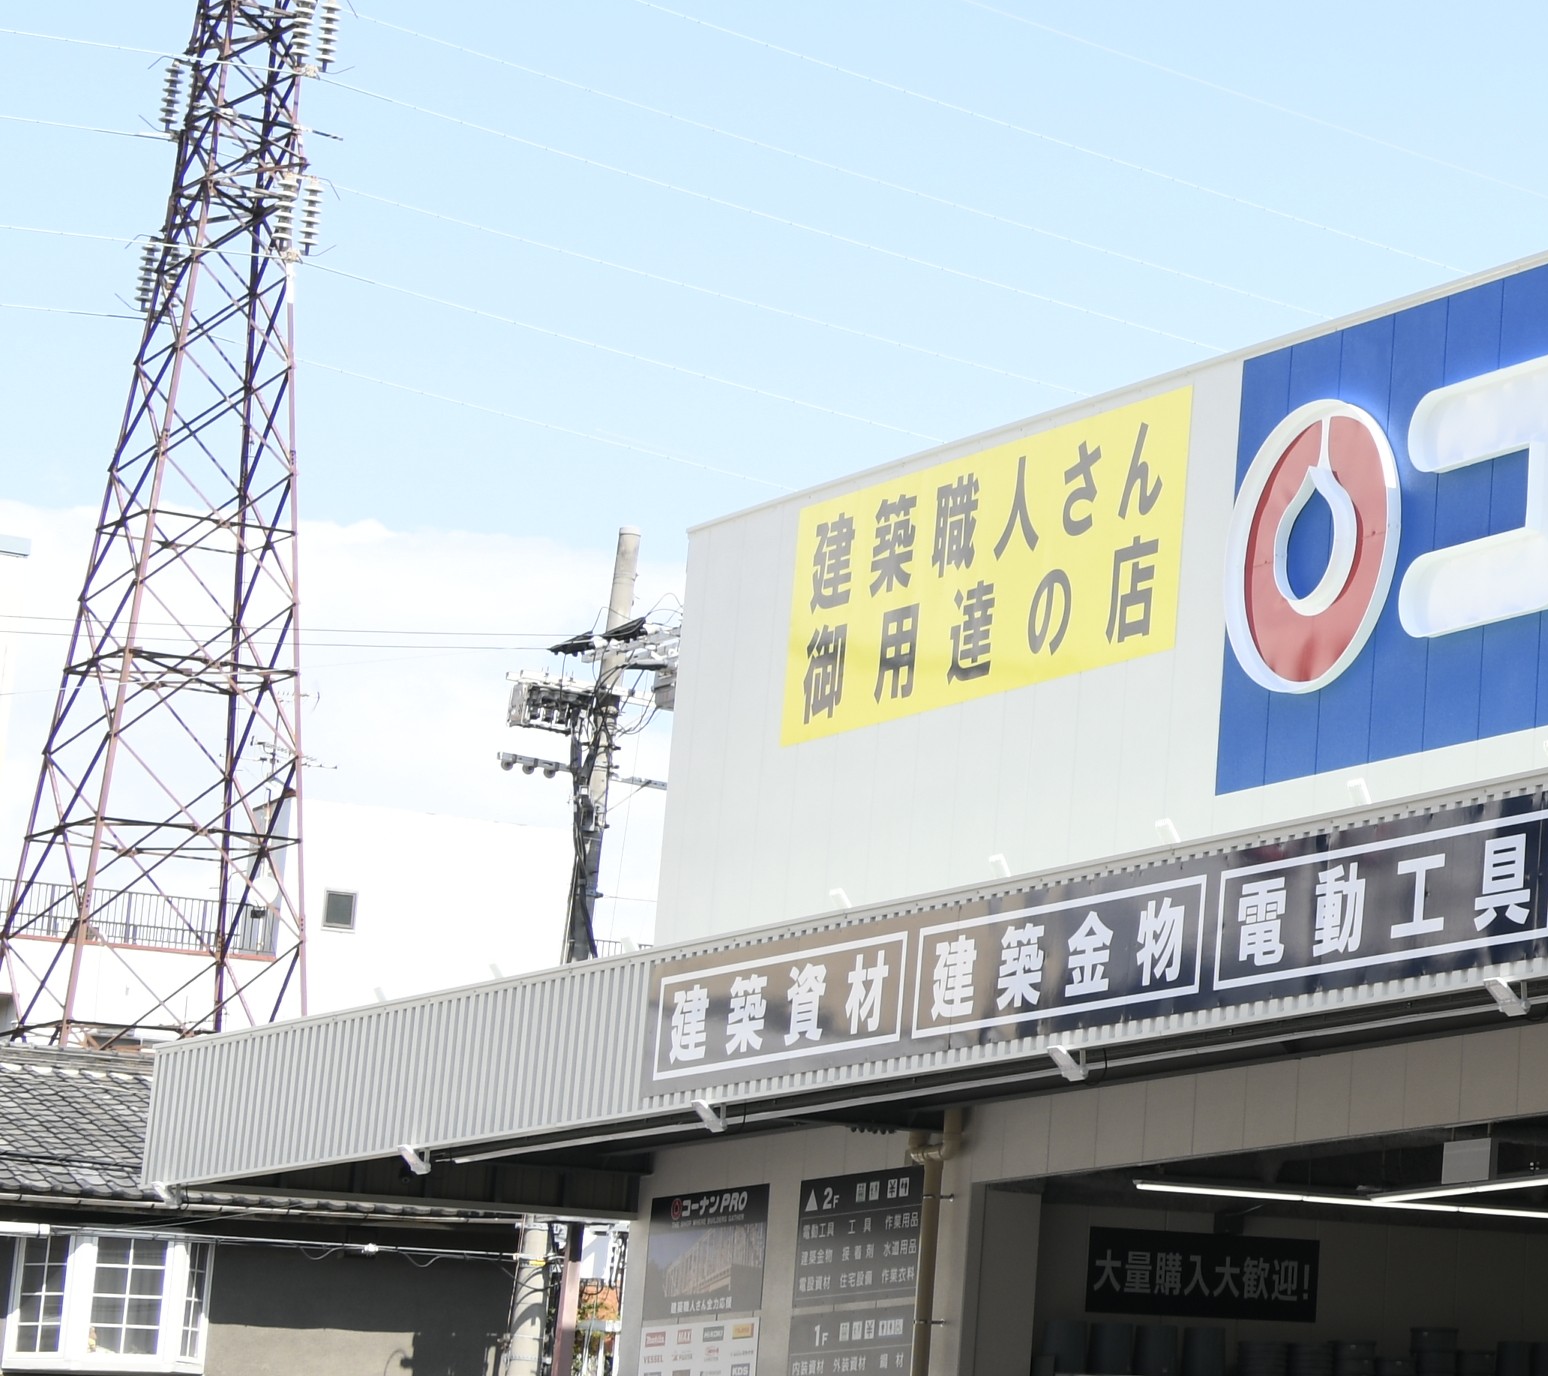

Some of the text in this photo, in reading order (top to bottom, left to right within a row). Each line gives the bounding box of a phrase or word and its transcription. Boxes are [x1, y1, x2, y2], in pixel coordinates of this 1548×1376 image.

[809, 422, 1162, 615] 建築職人さん
[802, 536, 1160, 726] 御用達の店
[931, 896, 1183, 1022] 建築金物
[1238, 836, 1532, 965] 電動工具
[669, 954, 888, 1064] 建築資材
[822, 1187, 840, 1210] 2F
[815, 1324, 828, 1346] 1F
[1093, 1248, 1312, 1304] 大量購入大歓迎!
